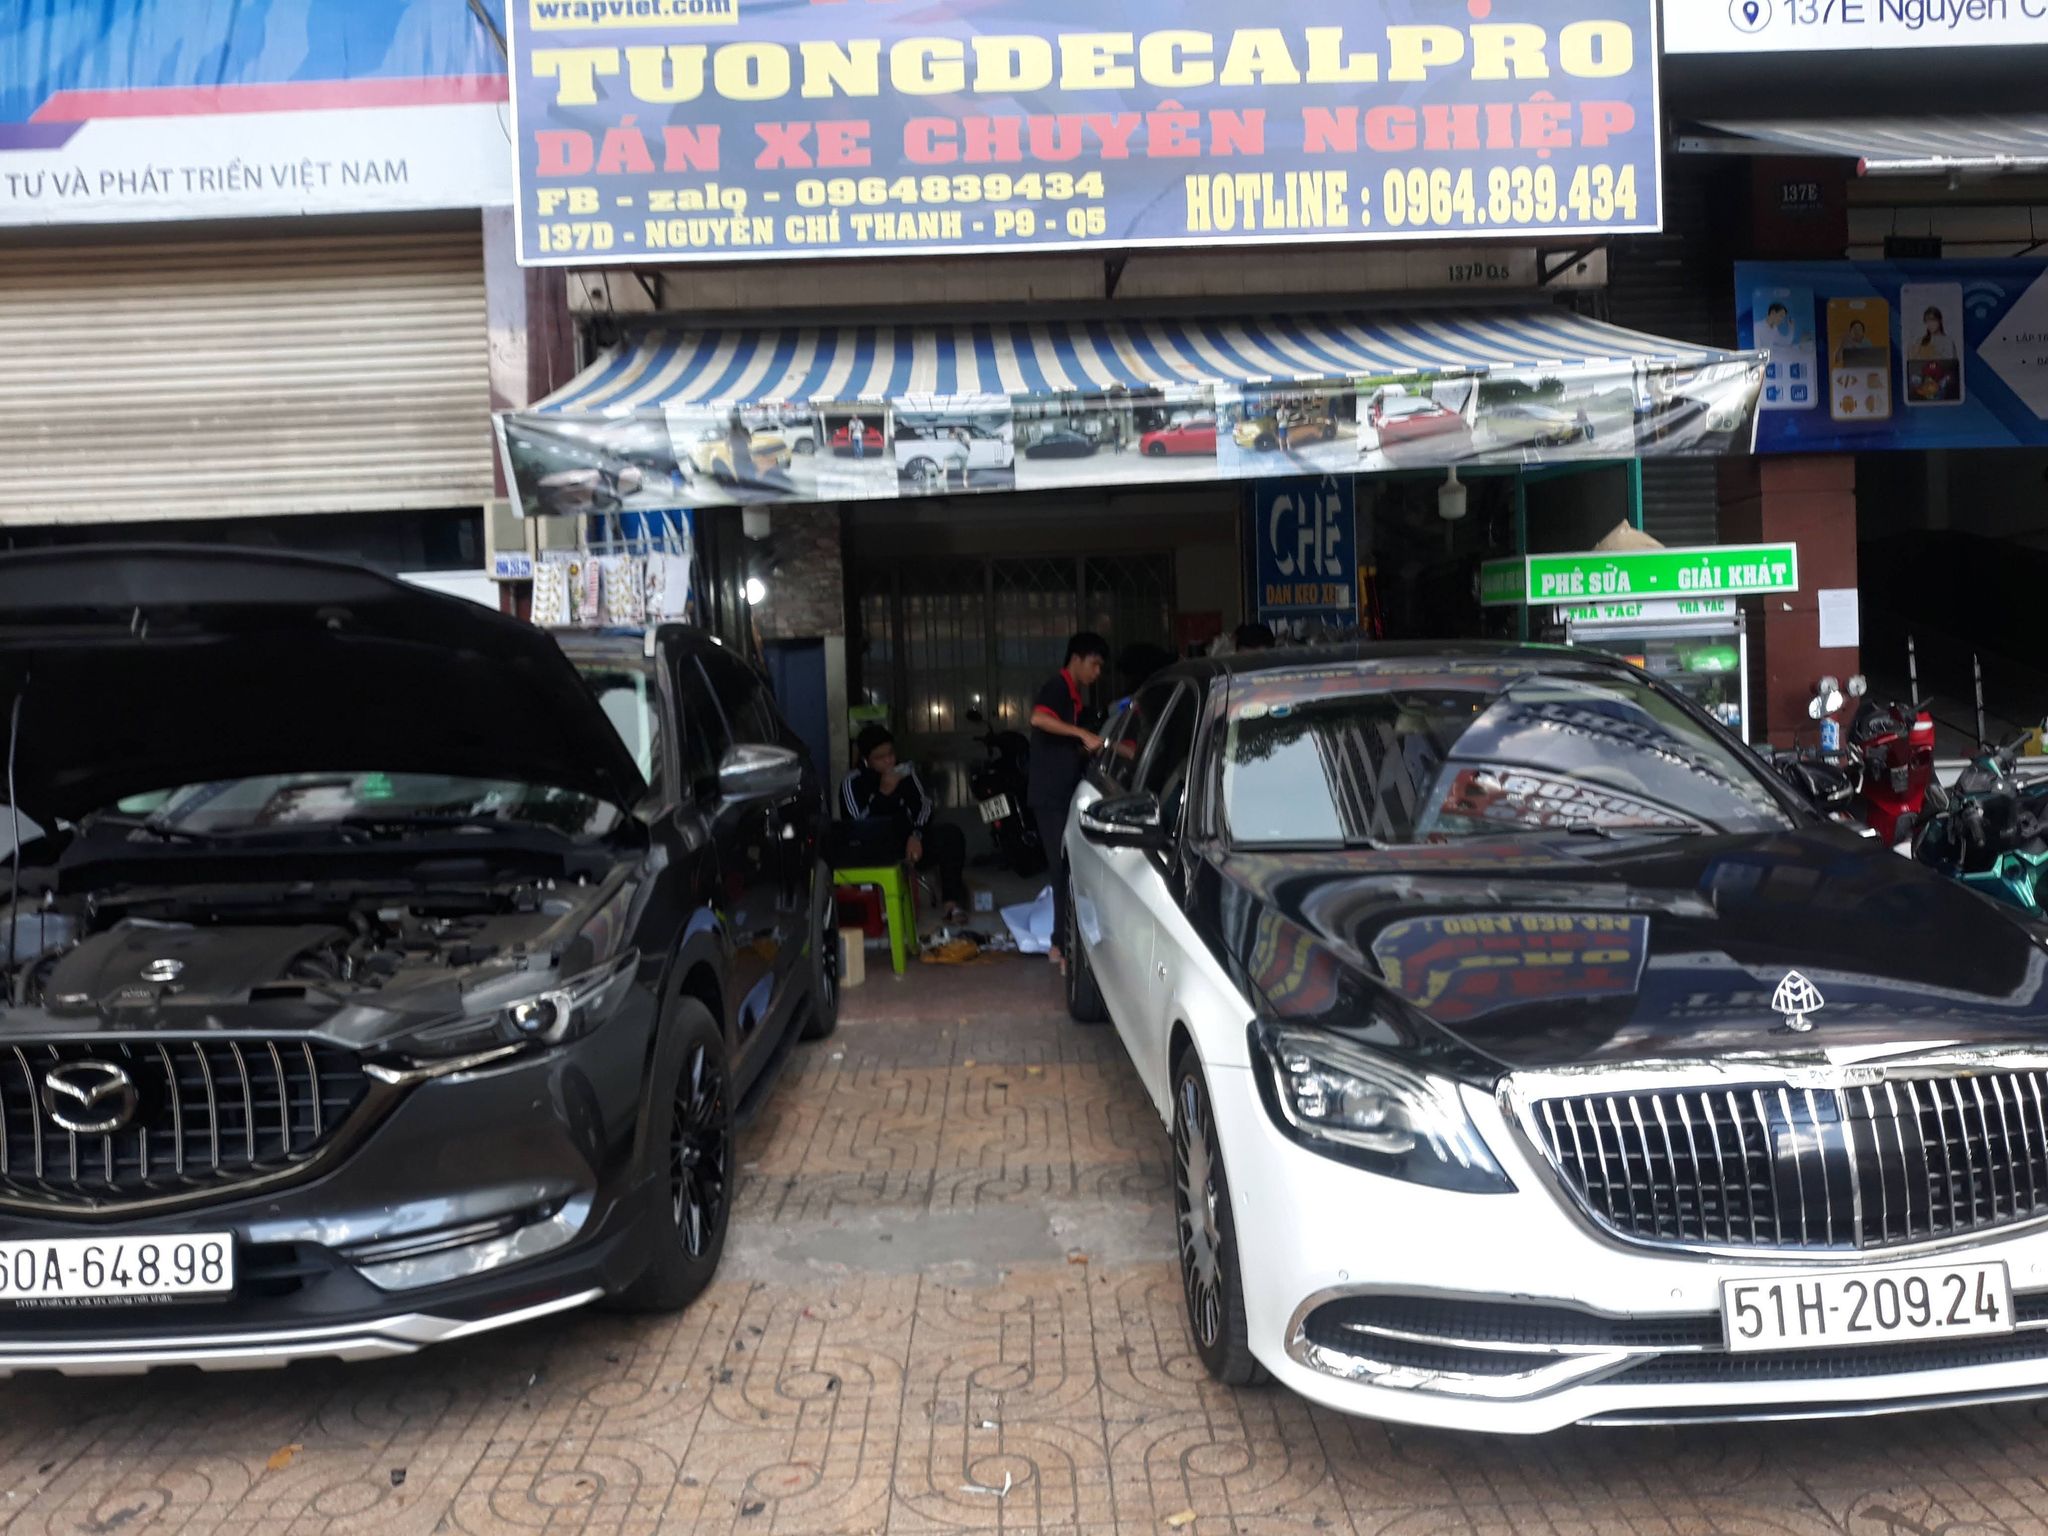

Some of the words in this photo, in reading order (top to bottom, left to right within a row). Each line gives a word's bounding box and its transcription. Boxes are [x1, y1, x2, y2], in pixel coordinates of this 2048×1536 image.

[537, 0, 731, 24] wrapviet.com
[535, 114, 720, 177] DÁN
[755, 120, 872, 170] XE
[904, 100, 1266, 164] CHUYÊN
[1302, 91, 1636, 158] NGHIỆP
[5, 169, 44, 199] TƯ
[53, 166, 90, 197] VÀ
[100, 163, 174, 194] PHÁT
[180, 157, 263, 193] TRIỂN
[270, 158, 332, 194] VIỆT
[341, 159, 409, 186] NAM
[537, 187, 599, 216] FB
[796, 173, 1106, 208] 0964839434
[1185, 170, 1349, 232] HOTLINE
[1383, 164, 1637, 226] 0964.839.434
[538, 221, 614, 253] 137D
[645, 211, 774, 248] NGUYỄN
[785, 209, 840, 244] CHÍ
[851, 211, 962, 242] THANH
[995, 208, 1035, 237] P9
[1067, 206, 1107, 236] Q5
[1541, 566, 1584, 596] PHÊ
[1678, 557, 1721, 589] GIẢI
[1728, 556, 1787, 588] KHÁT
[1734, 1271, 2000, 1338] 51H-209.24
